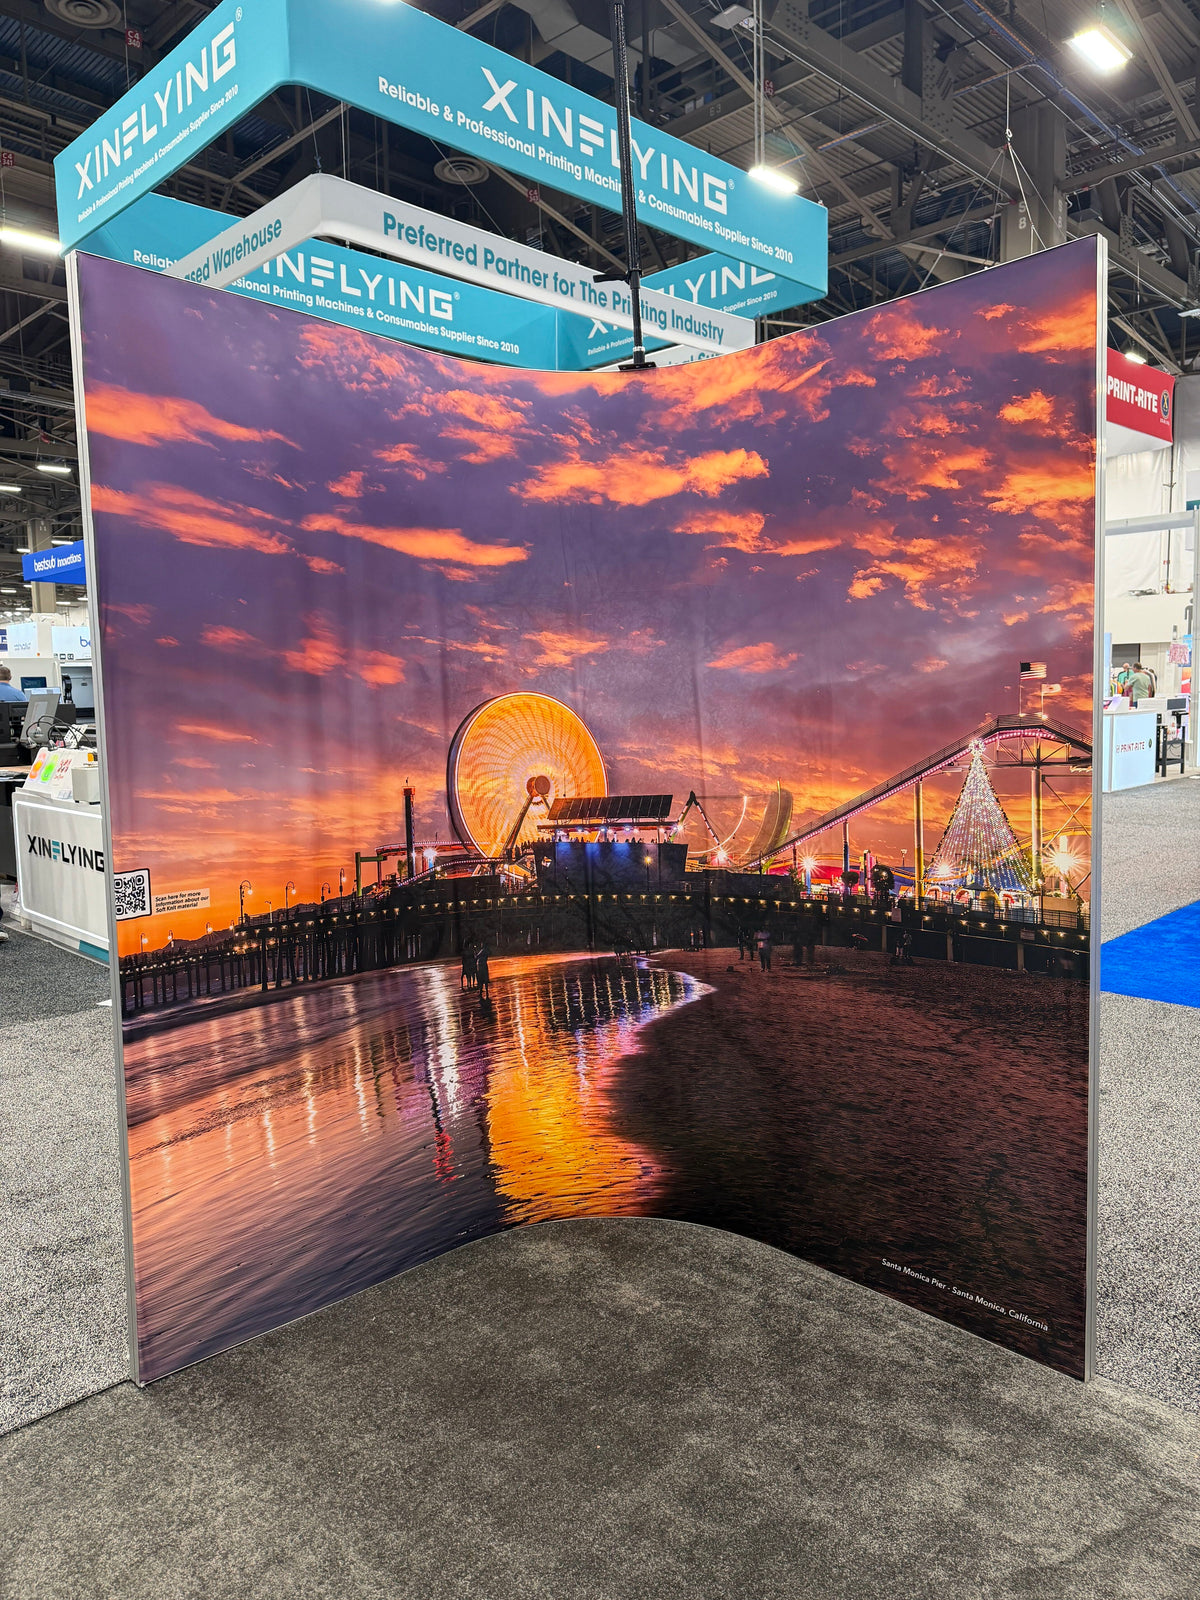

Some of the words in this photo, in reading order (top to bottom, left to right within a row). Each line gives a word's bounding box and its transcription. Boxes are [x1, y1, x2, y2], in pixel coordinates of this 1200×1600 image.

[75, 22, 236, 200] XINFLYING
[189, 110, 210, 133] Supplier
[210, 97, 225, 115] Since
[225, 84, 238, 103] 2010
[378, 76, 440, 117] Reliable
[443, 105, 454, 122] &
[456, 111, 536, 158] Professional
[538, 146, 582, 180] Printing
[638, 189, 646, 204] &
[648, 194, 713, 232] Consumables
[714, 219, 750, 247] Supplier
[751, 236, 774, 257] Since
[775, 246, 793, 264] 2010
[133, 249, 177, 269] Reliab
[213, 218, 282, 275] Warehouse
[383, 211, 477, 266] Preferred
[484, 247, 548, 289] Partner
[553, 271, 575, 297] for
[580, 279, 608, 308] The
[612, 291, 667, 331] Priting
[671, 309, 724, 345] Industry
[263, 252, 453, 321] NFLYING
[273, 285, 313, 307] Printing
[315, 296, 365, 317] Machines
[366, 307, 374, 318] &
[376, 309, 439, 335] Consumables
[440, 326, 475, 344] Supplier
[476, 335, 500, 350] Since
[500, 341, 520, 355] 2010
[746, 295, 762, 306] Since
[763, 290, 778, 301] 2010
[27, 834, 105, 873] XINFLYING
[881, 1258, 902, 1272] Santa
[902, 1266, 930, 1283] Monica
[931, 1277, 946, 1290] Pier
[952, 1286, 974, 1301] Santa
[975, 1295, 1007, 1316] Monica,
[1008, 1309, 1049, 1332] California
